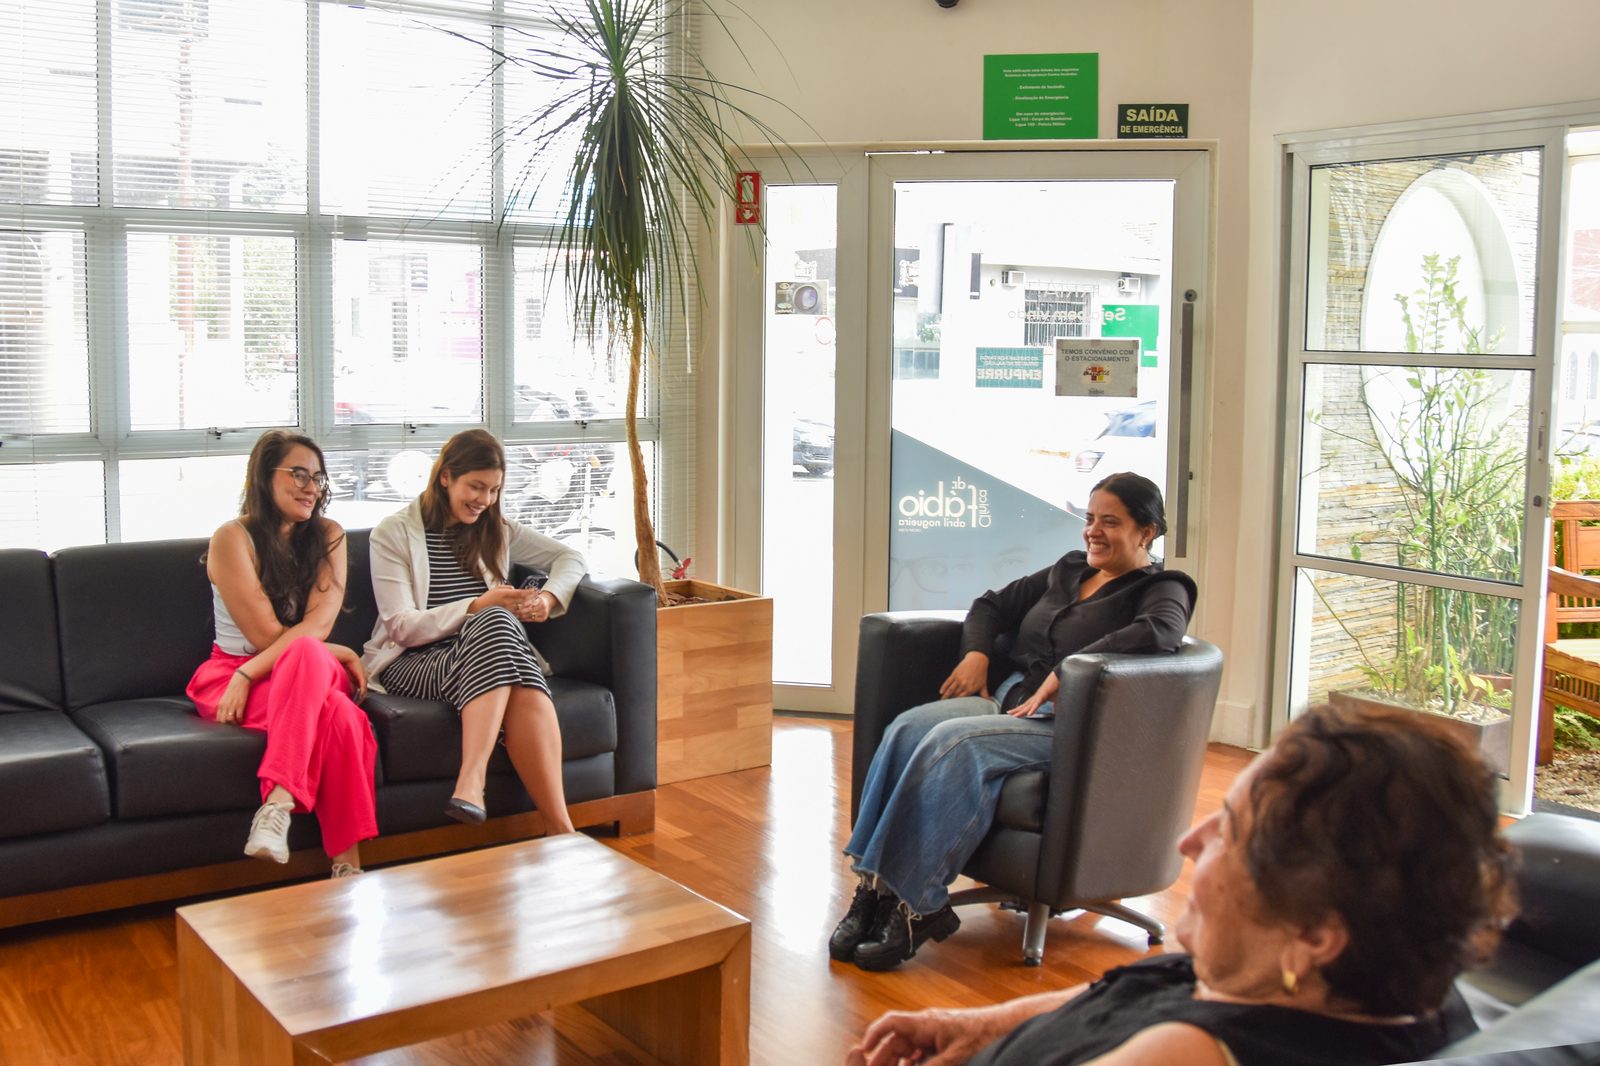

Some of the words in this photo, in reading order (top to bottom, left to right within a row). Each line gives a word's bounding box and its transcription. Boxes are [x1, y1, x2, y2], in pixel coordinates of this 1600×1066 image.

[1126, 106, 1179, 121] SAÍDA
[1120, 125, 1131, 133] DE
[1132, 123, 1184, 134] EMERGÊNCIA
[1084, 347, 1118, 355] CONVÊNIO
